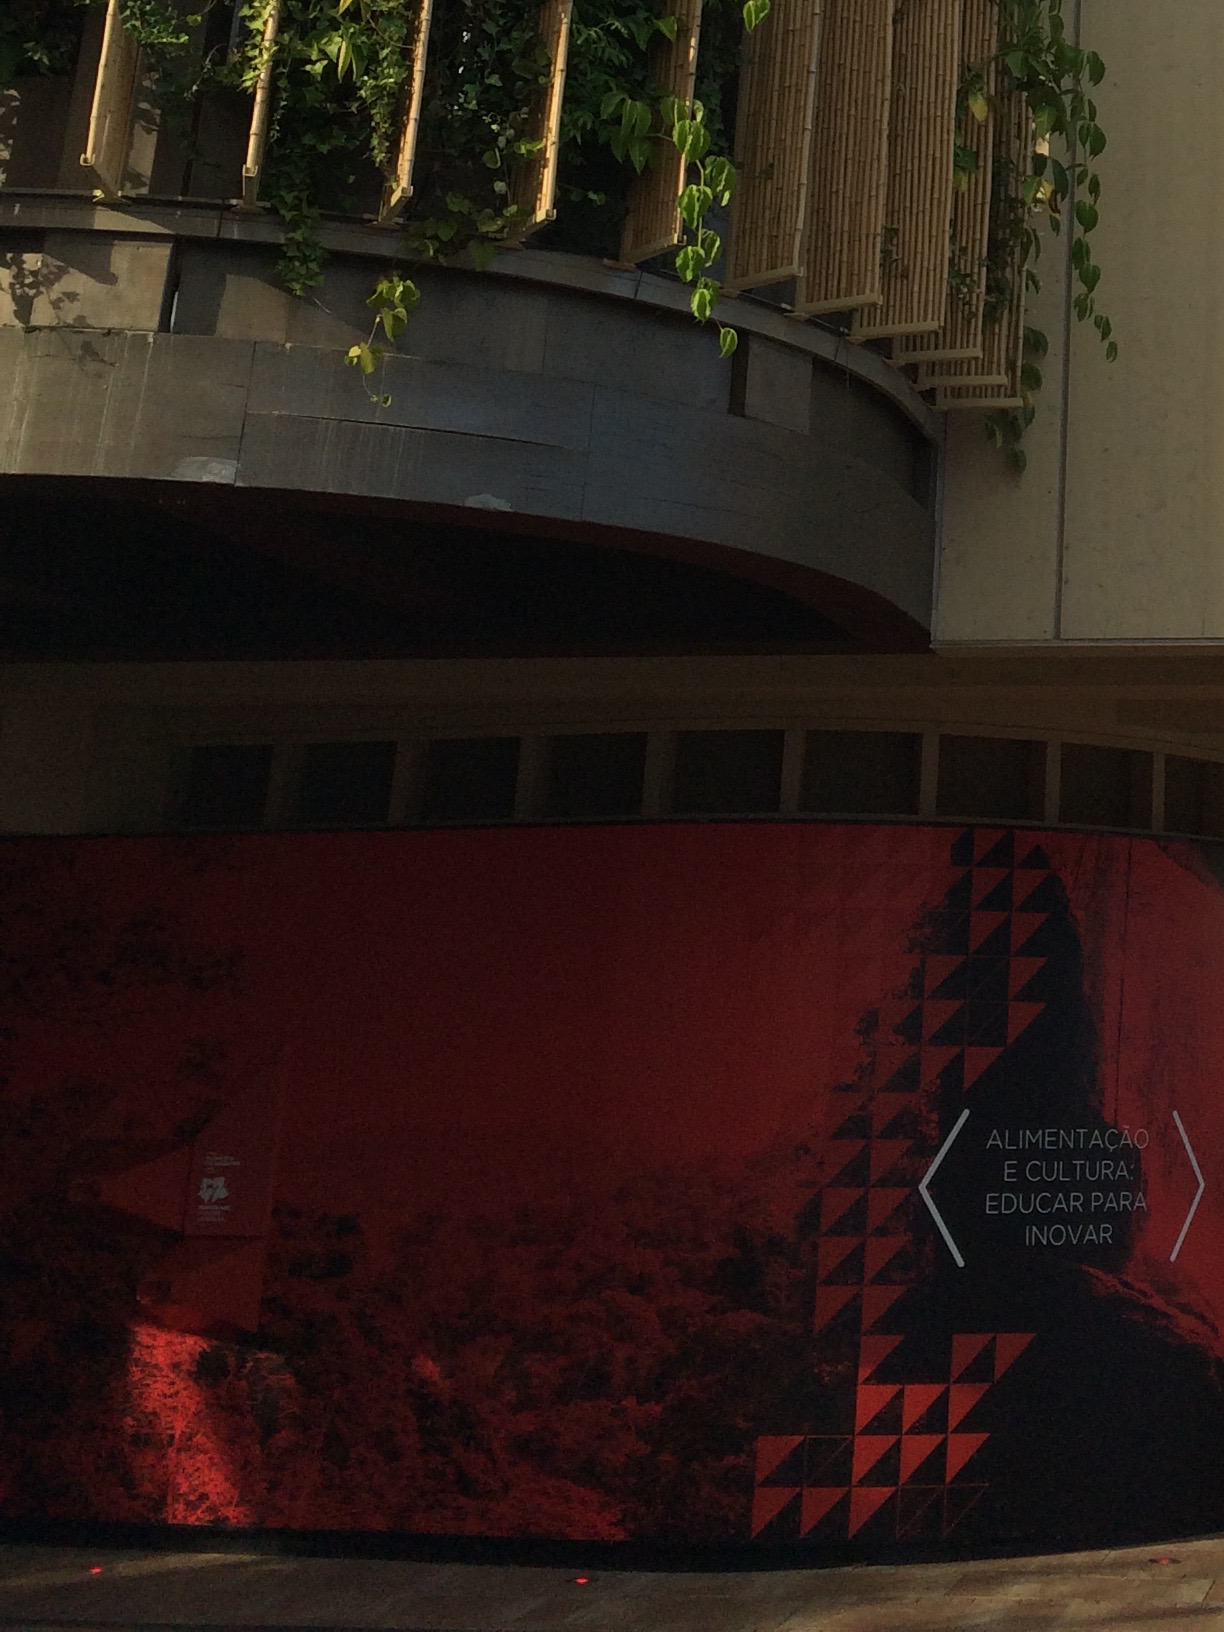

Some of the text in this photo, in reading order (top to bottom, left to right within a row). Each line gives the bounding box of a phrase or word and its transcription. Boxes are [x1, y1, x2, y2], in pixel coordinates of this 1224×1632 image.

[987, 1125, 1149, 1151] ALIMENTAÇÃO
[1004, 1160, 1134, 1182] E CULTURA:
[987, 1192, 1148, 1214] EDUCAR PARA
[1026, 1225, 1113, 1246] INOVAR
